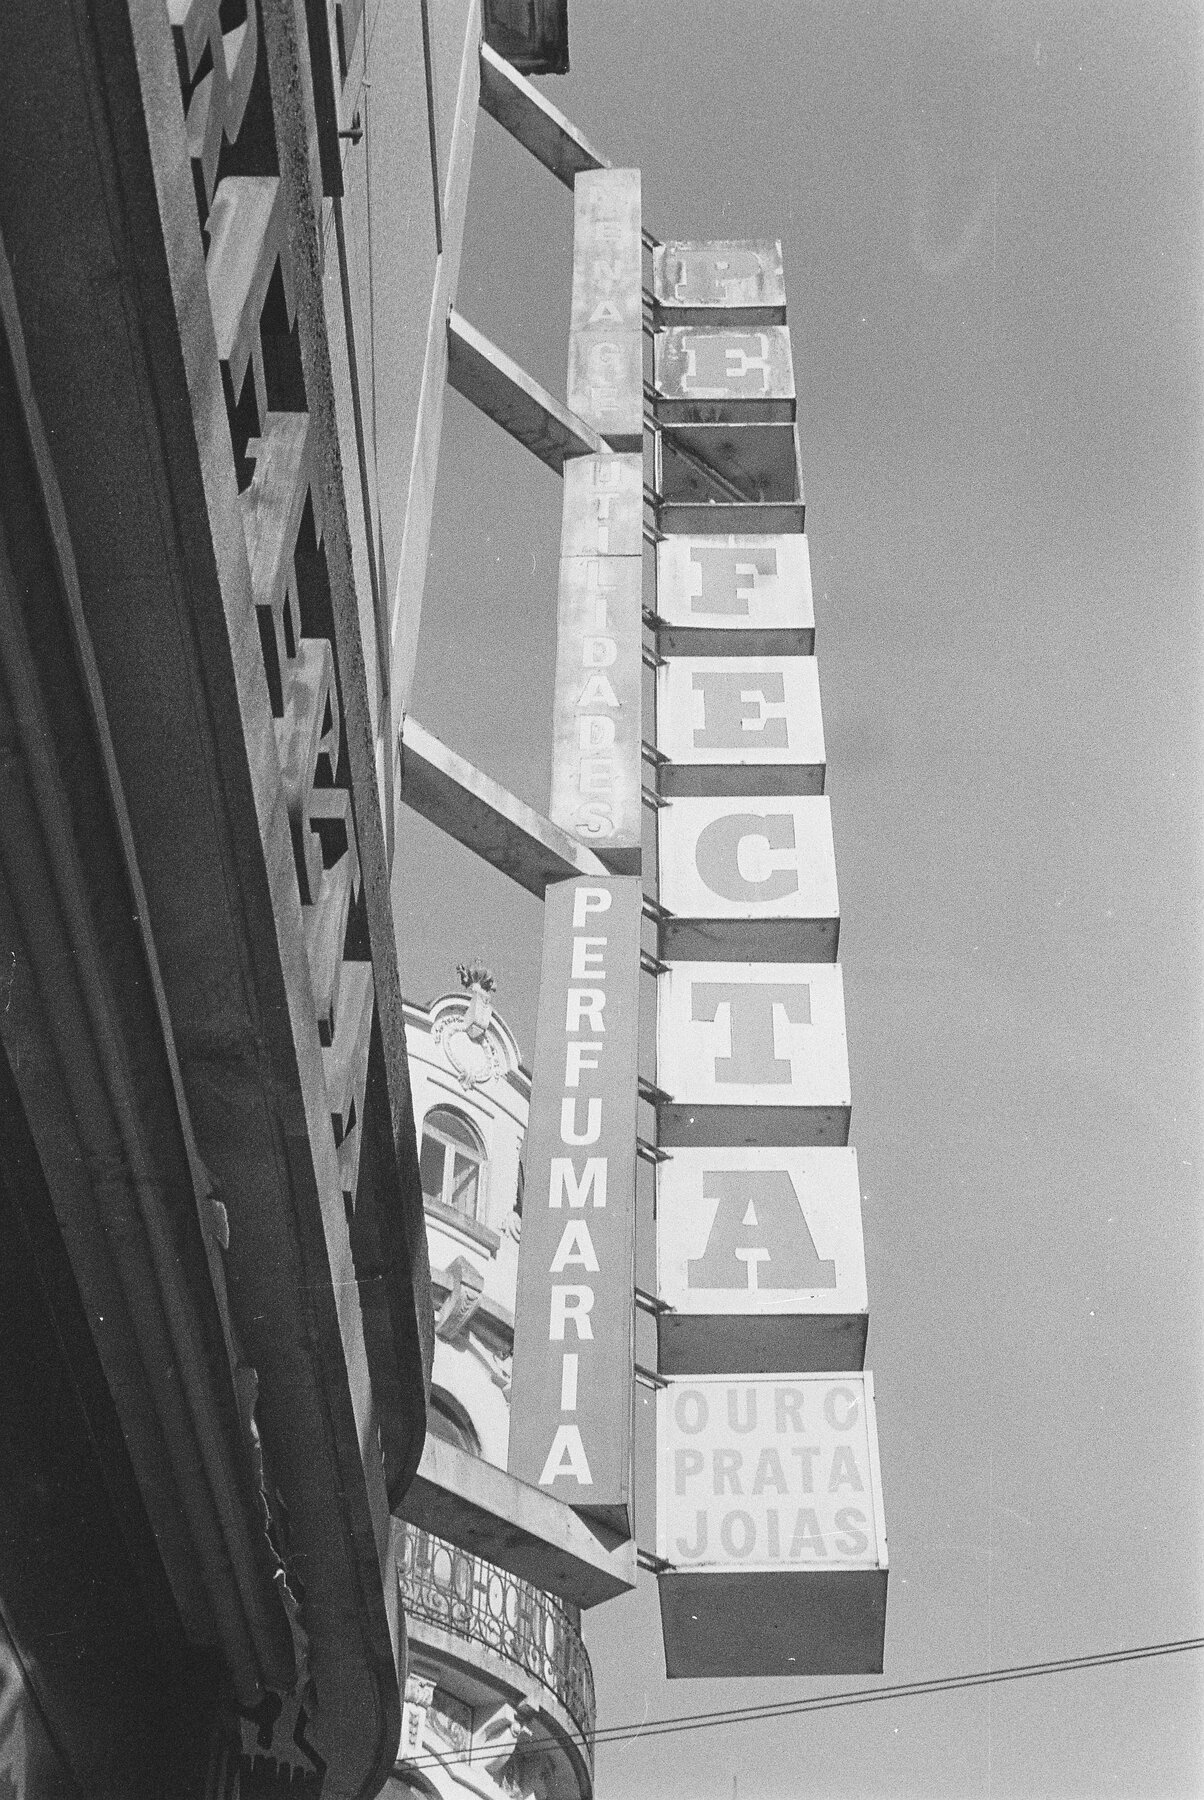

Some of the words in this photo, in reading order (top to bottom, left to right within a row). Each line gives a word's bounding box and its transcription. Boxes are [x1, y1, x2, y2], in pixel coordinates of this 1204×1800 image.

[675, 249, 835, 1289] PEFECTA
[538, 887, 612, 1485] PERFUMARIA
[675, 1387, 858, 1435] OURO
[675, 1446, 864, 1496] PRATA
[676, 1507, 868, 1559] JOIAS
